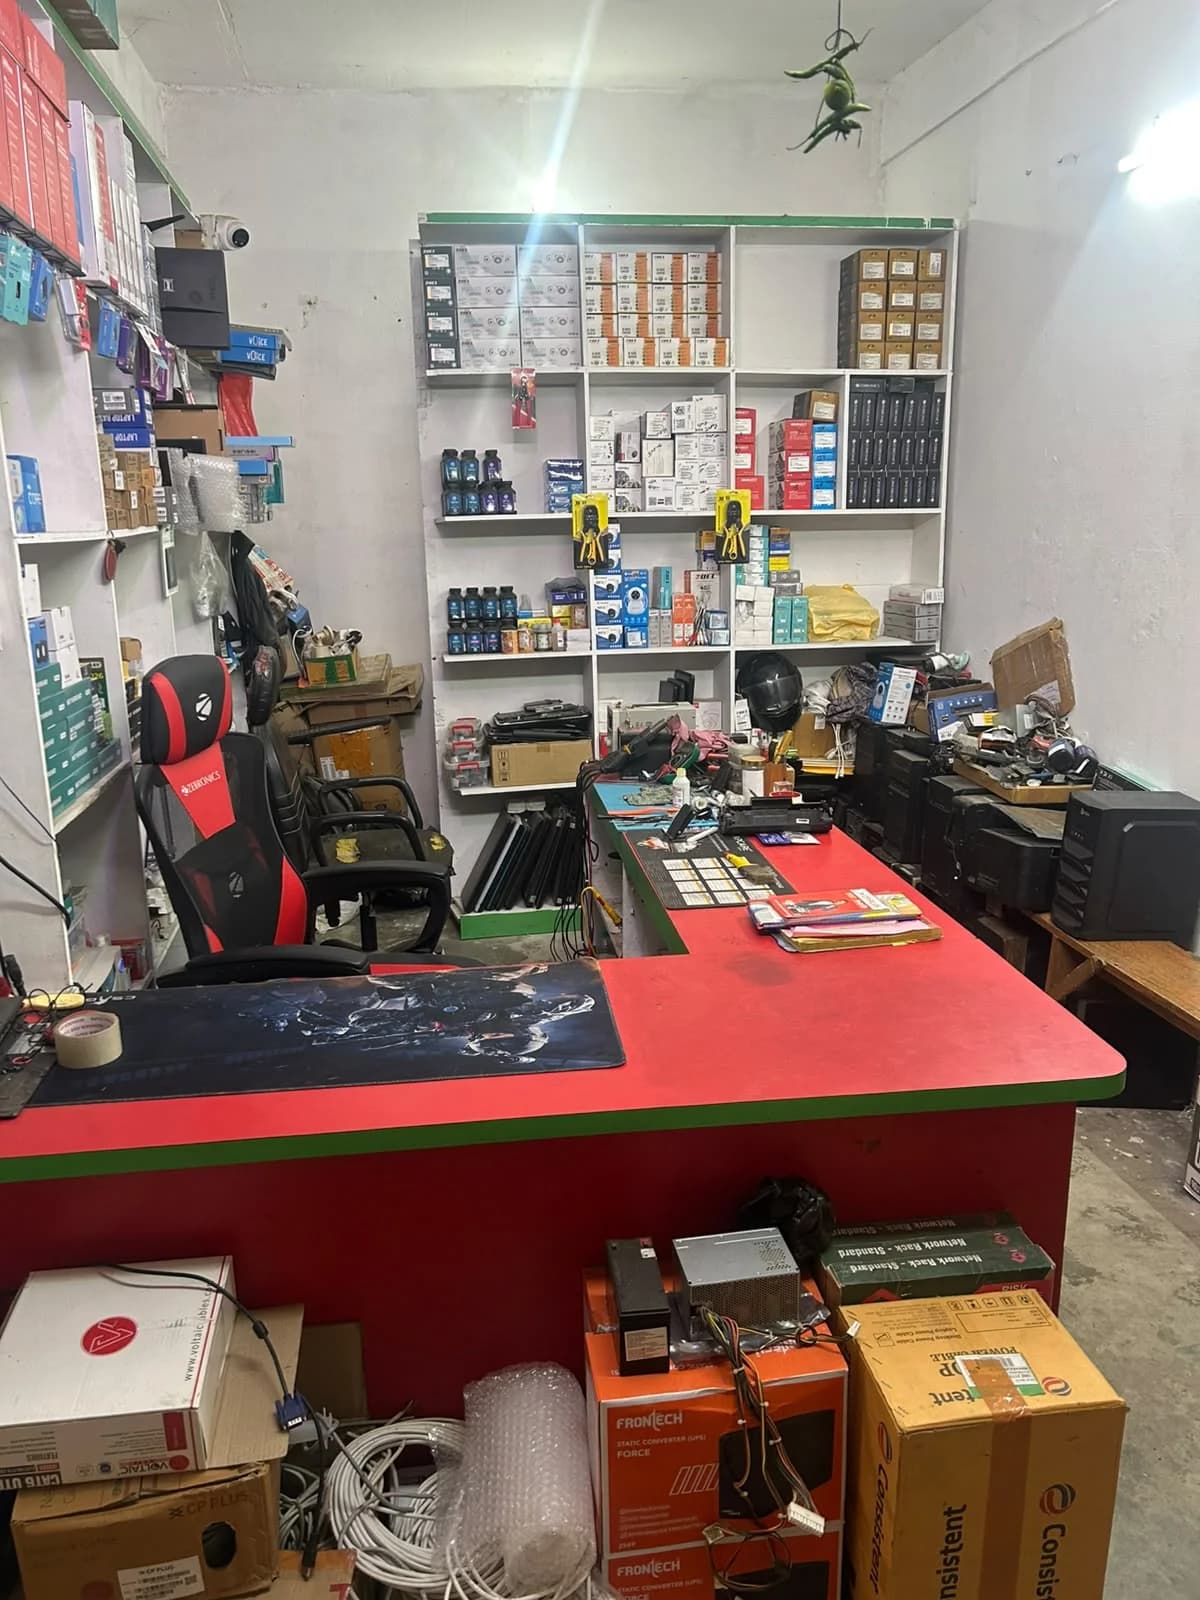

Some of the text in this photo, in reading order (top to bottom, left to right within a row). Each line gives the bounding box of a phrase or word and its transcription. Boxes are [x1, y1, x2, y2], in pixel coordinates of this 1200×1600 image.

[186, 770, 221, 793] ZEBRONICS
[894, 1242, 922, 1252] Rack
[923, 1237, 967, 1249] Network
[838, 1245, 886, 1258] Standard
[910, 1258, 936, 1267] Rack
[936, 1254, 983, 1265] Network
[850, 1261, 900, 1273] Standard
[929, 1390, 976, 1406] tent
[616, 1408, 683, 1432] FRONTECH
[642, 1435, 686, 1446] CONVERTER
[617, 1448, 651, 1458] FORCE
[119, 1461, 168, 1474] VOLTAIC
[25, 1473, 61, 1487] CAT6
[186, 1500, 207, 1514] CP
[936, 1504, 967, 1600] nsistent
[1036, 1523, 1066, 1600] Consis
[617, 1559, 681, 1578] FRONTECH
